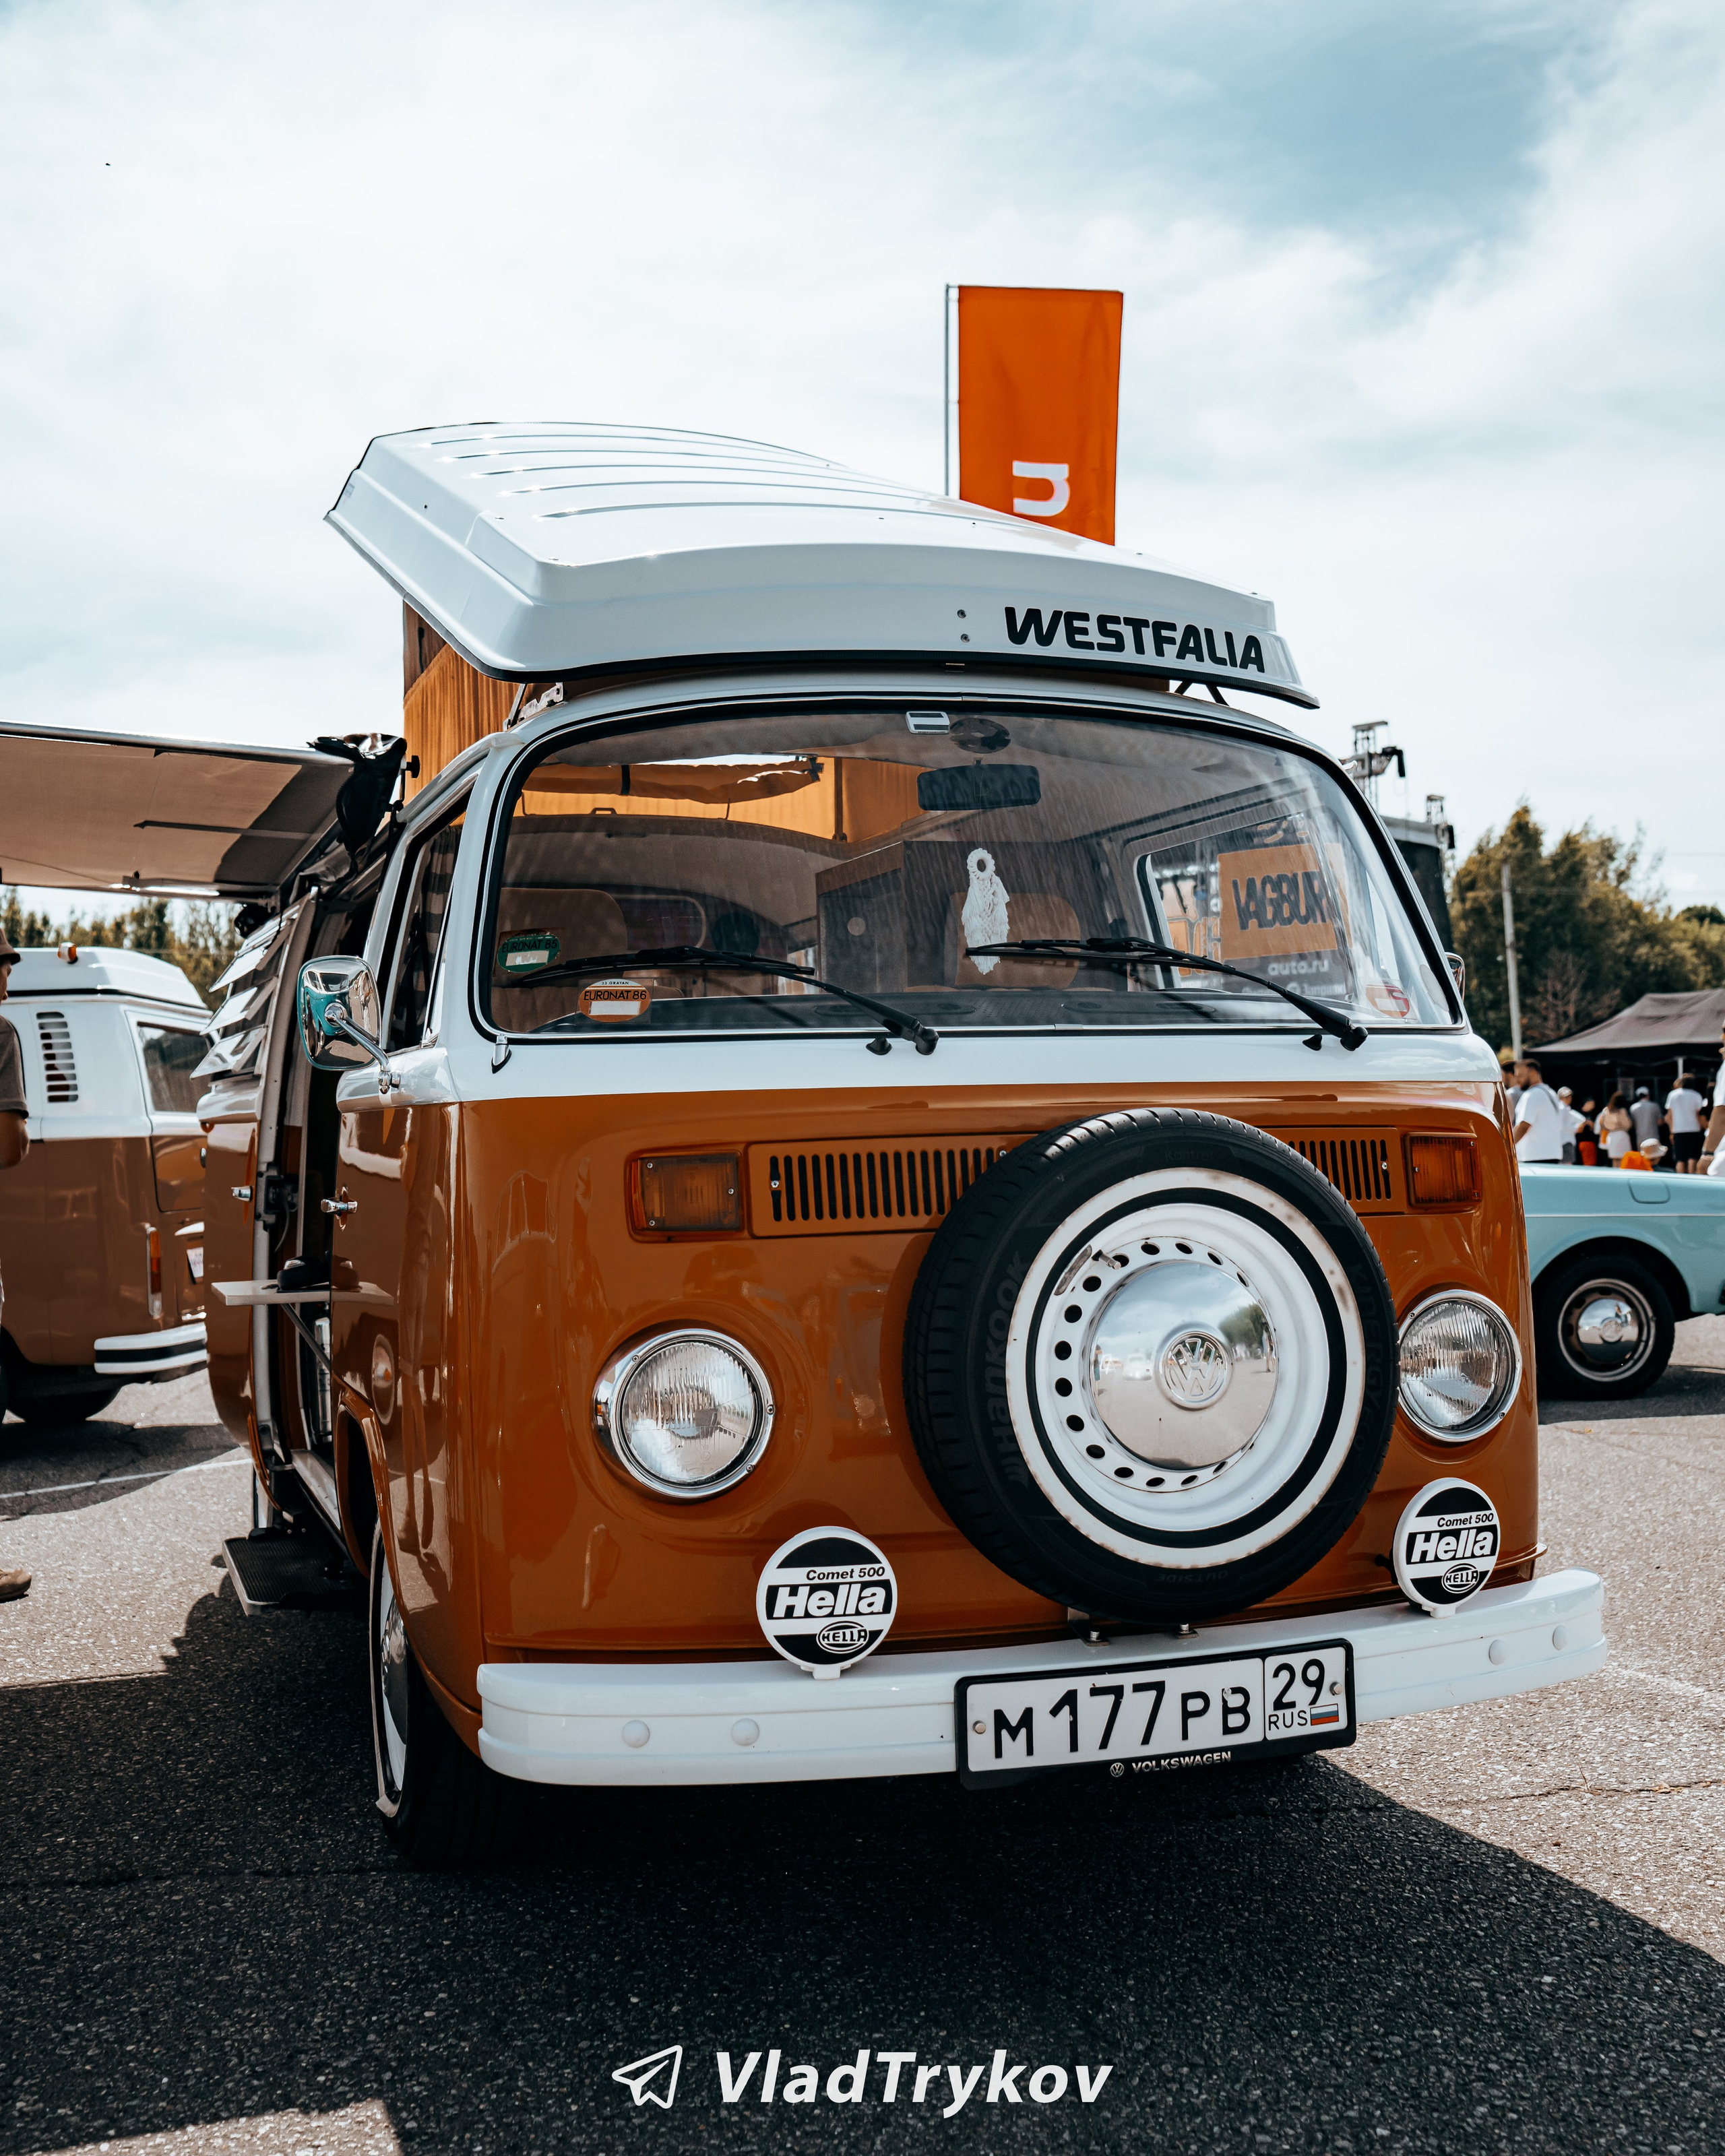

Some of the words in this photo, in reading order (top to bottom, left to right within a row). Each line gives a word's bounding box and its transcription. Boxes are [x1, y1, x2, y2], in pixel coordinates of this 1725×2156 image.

[1004, 606, 1265, 673] WESTFALIA
[502, 940, 542, 953] EURONAT
[544, 939, 558, 949] 85
[584, 990, 631, 1001] EURONAT
[632, 990, 647, 1001] 86
[1437, 1515, 1472, 1527] Comet
[1474, 1513, 1494, 1524] 500
[1411, 1529, 1494, 1562] Hella
[806, 1568, 855, 1581] Comet
[858, 1566, 885, 1578] 500
[1445, 1570, 1479, 1583] HELLA
[773, 1583, 885, 1618] Hella
[821, 1628, 868, 1642] HELLA
[1272, 1659, 1325, 1711] 29
[1268, 1709, 1308, 1731] RUS
[1132, 1751, 1231, 1773] VOLKSWAGEN
